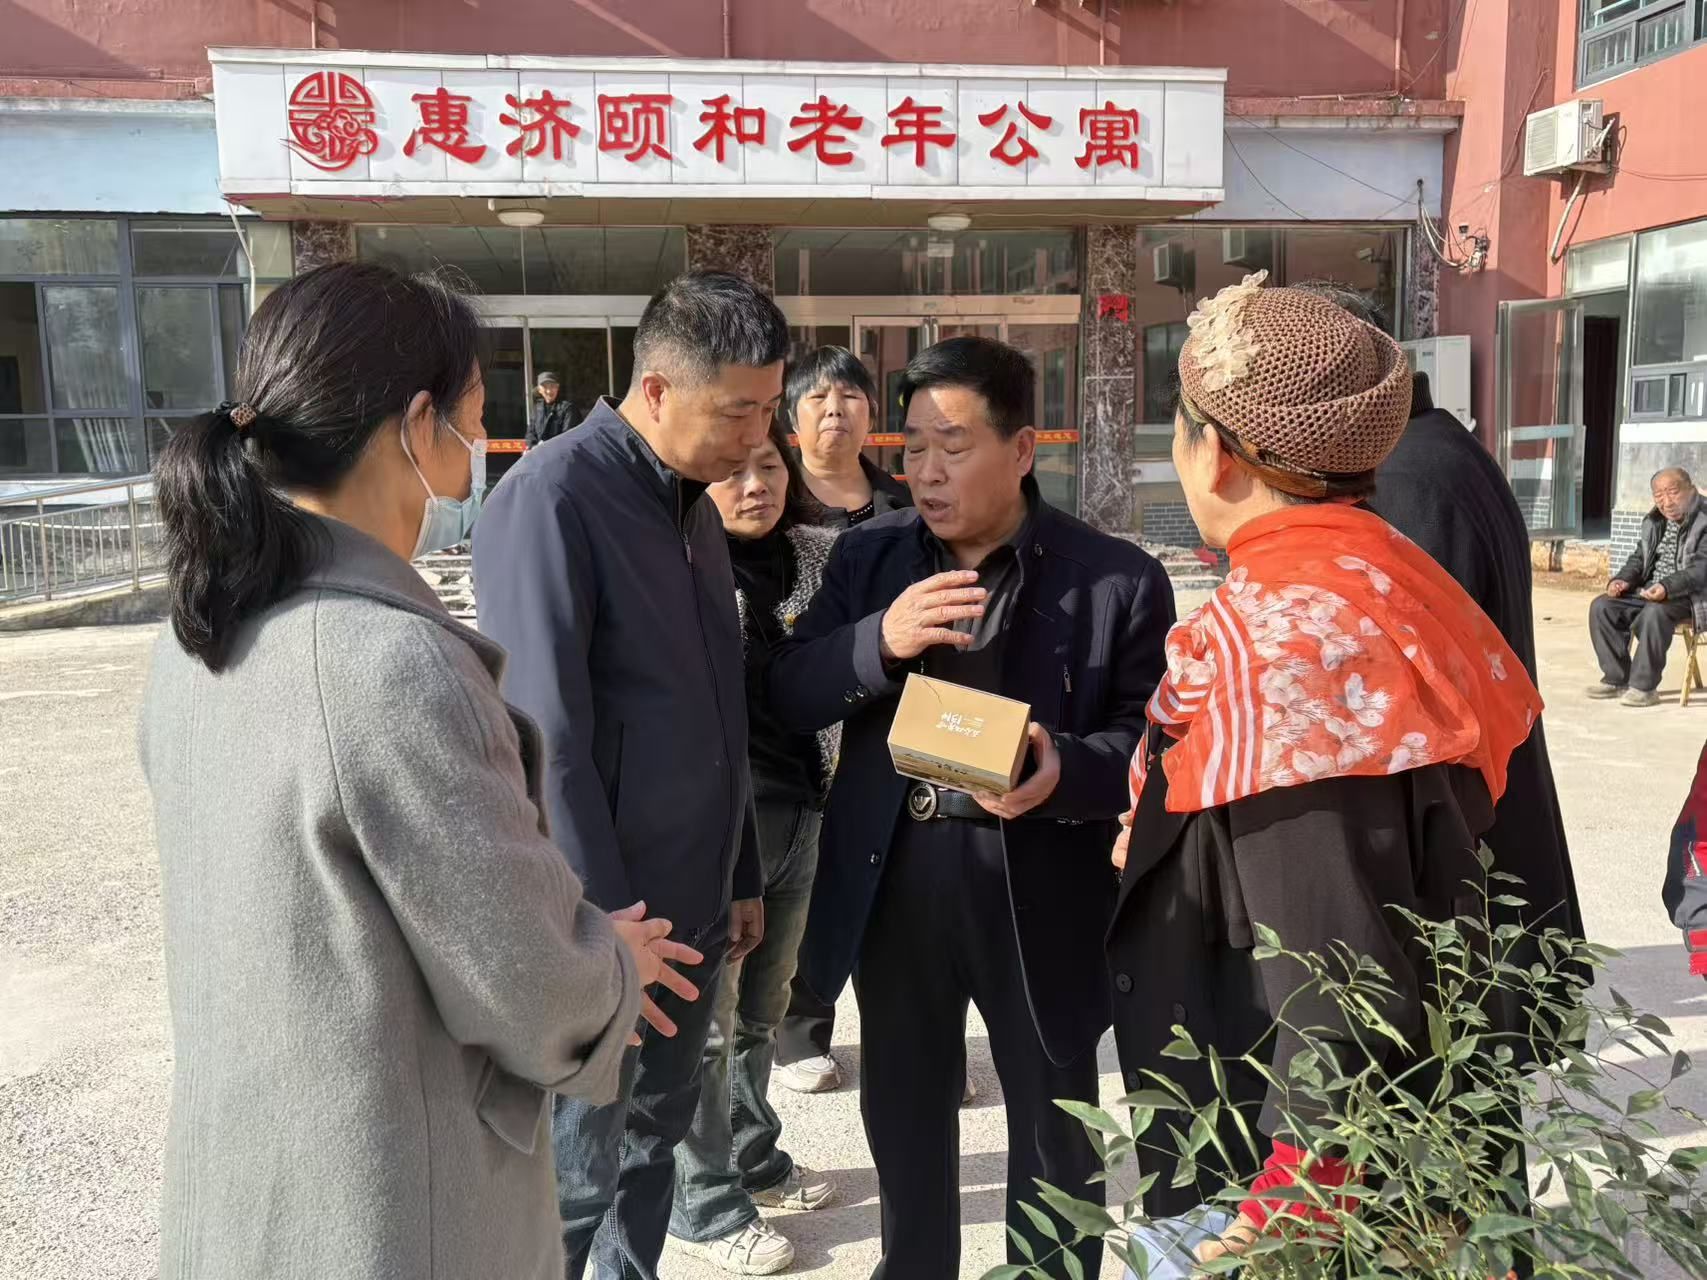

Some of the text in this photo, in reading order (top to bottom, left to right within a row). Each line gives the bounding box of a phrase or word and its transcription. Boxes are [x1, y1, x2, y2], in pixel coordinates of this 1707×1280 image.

[403, 88, 1141, 170] 惠济颐和老年公寓
